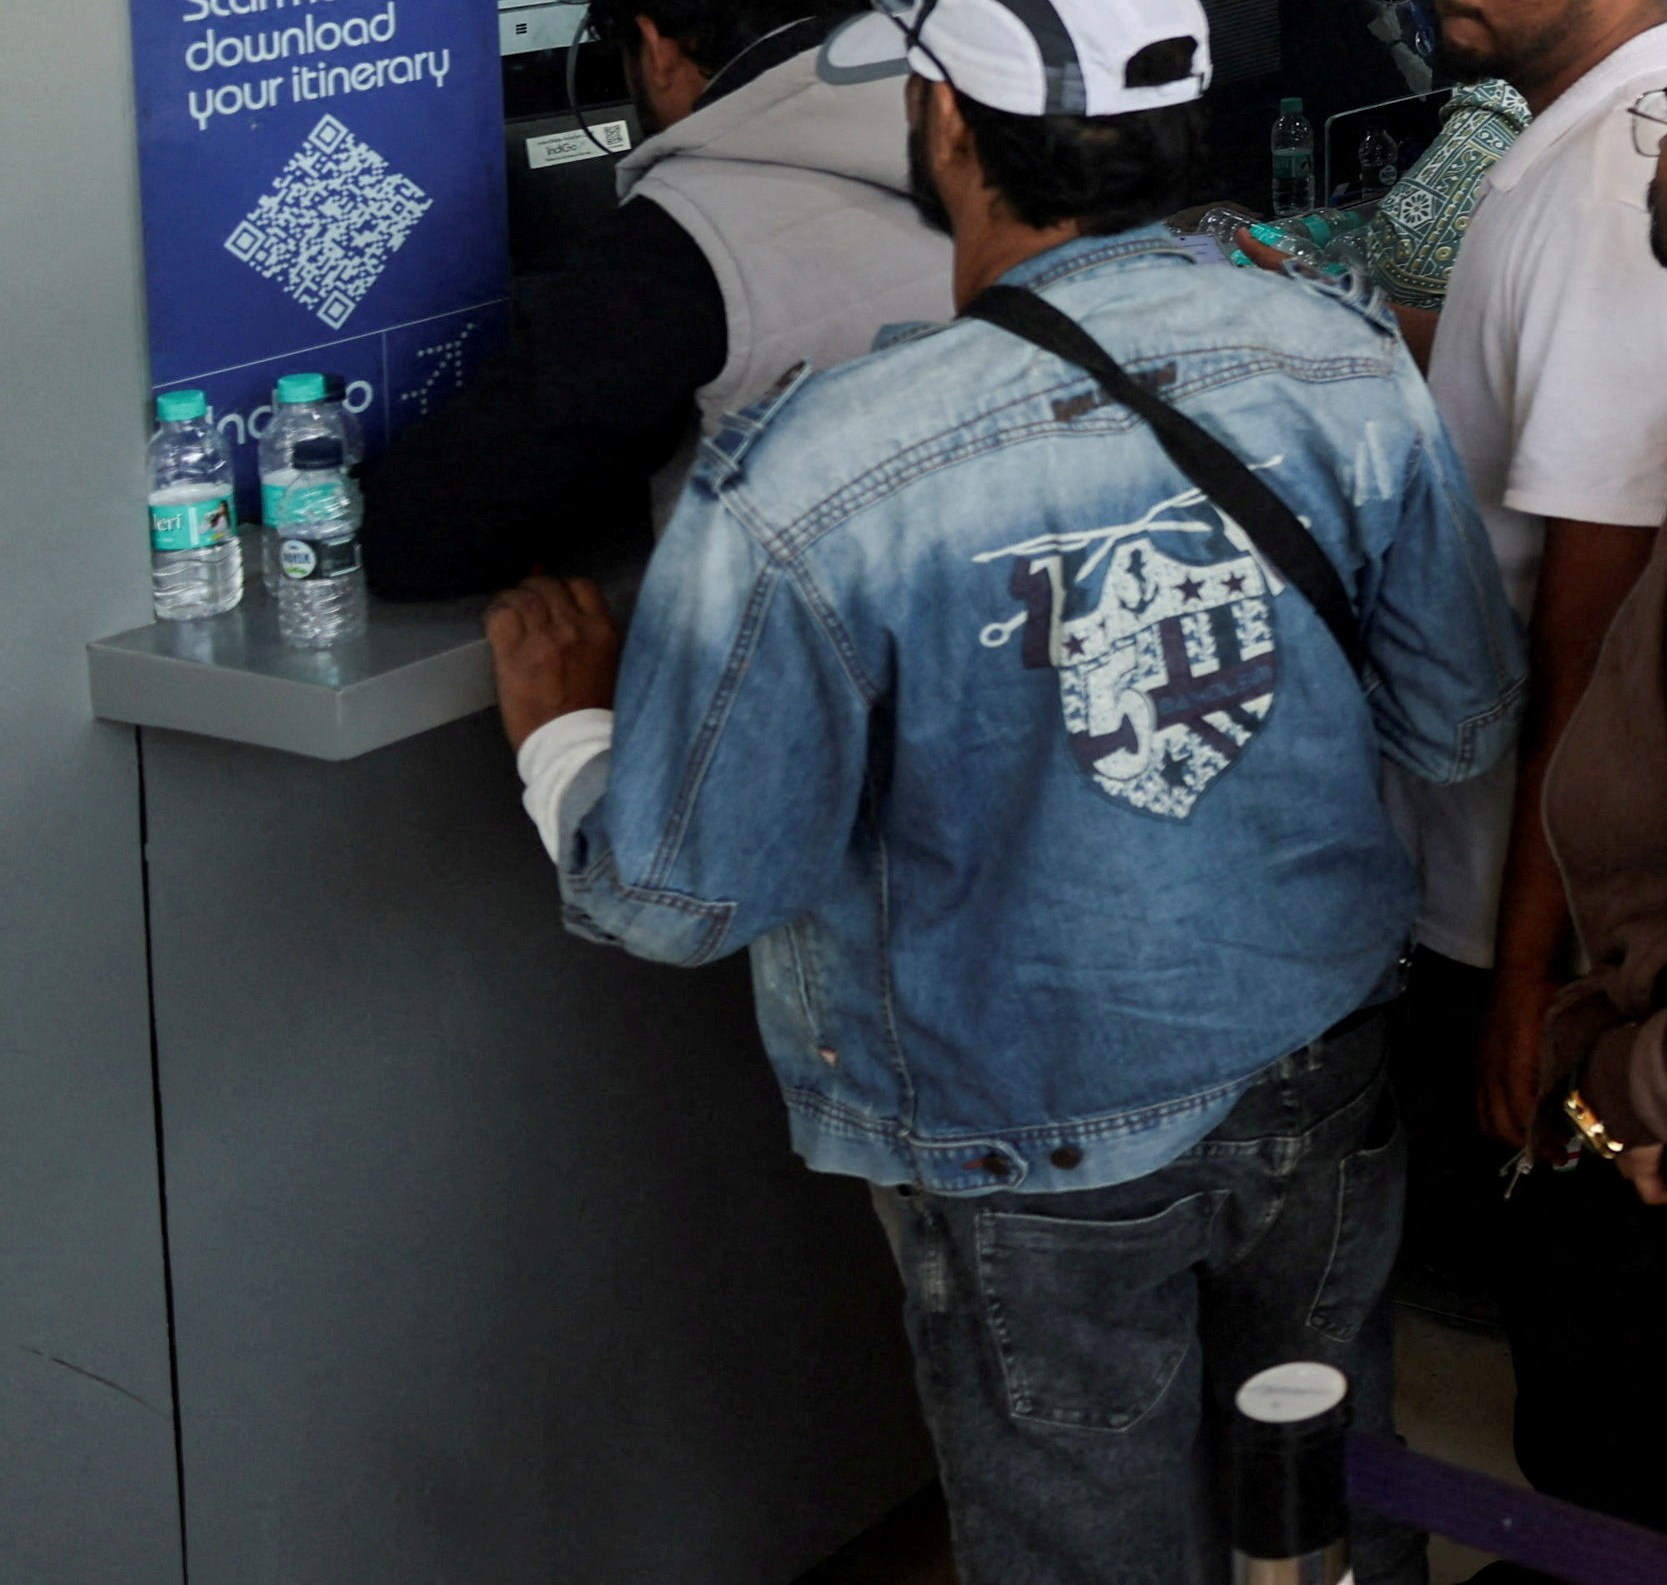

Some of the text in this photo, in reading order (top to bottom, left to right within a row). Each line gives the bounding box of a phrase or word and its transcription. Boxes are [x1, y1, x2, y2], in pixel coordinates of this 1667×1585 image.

[185, 1, 397, 72] download
[188, 48, 450, 131] your itinerary
